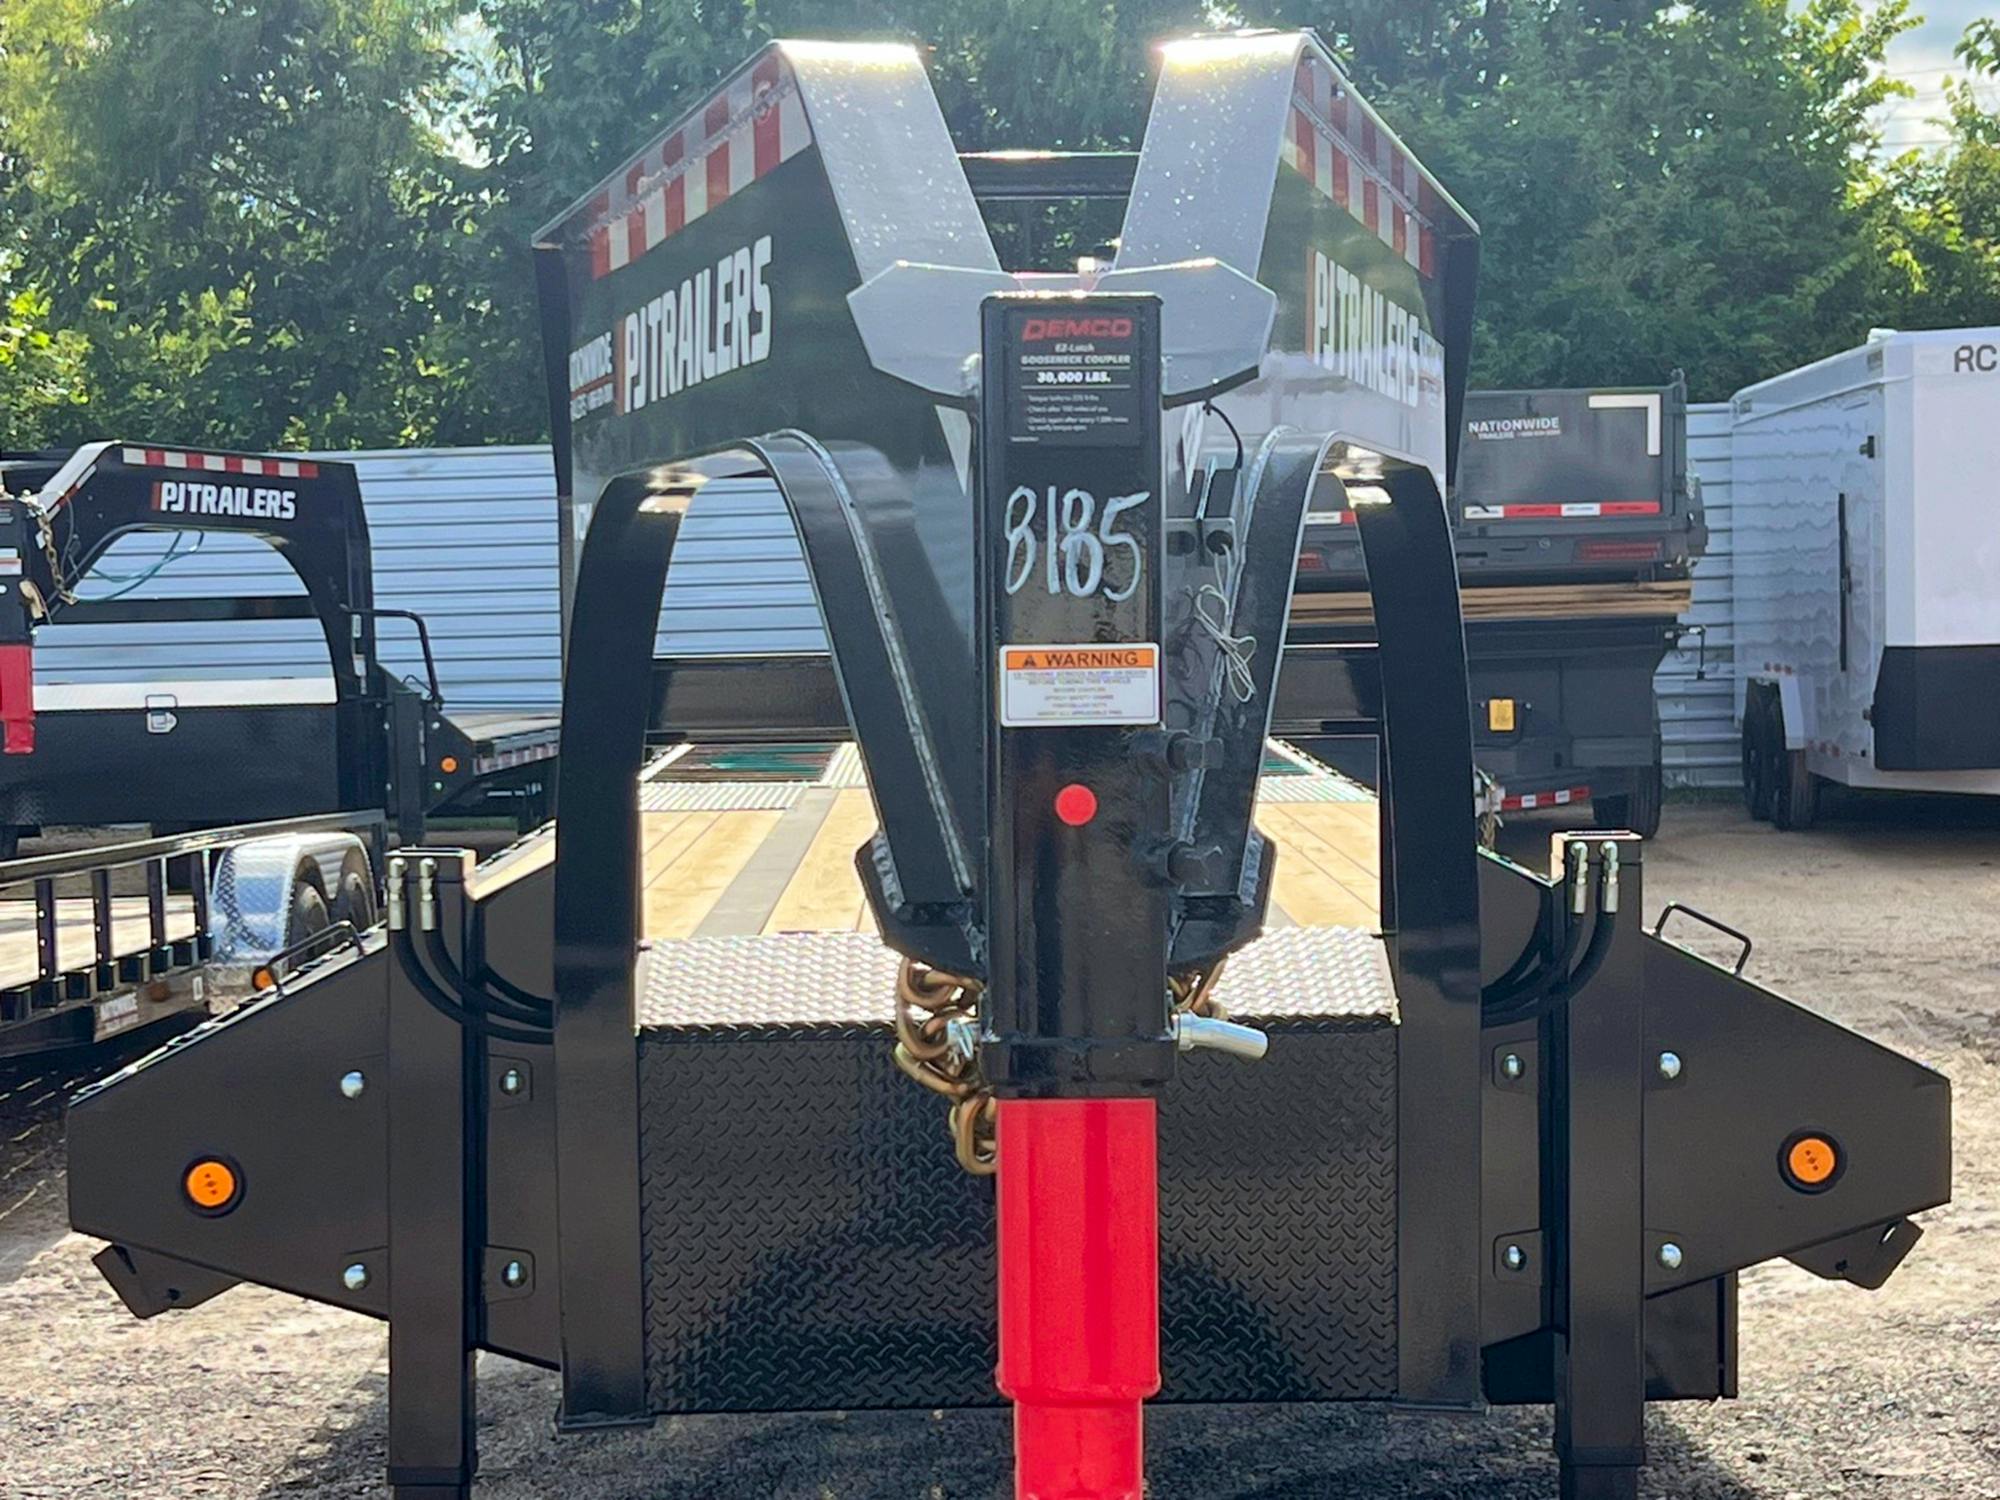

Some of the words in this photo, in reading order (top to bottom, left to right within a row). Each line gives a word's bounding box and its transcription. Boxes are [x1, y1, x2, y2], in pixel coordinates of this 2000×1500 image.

[1023, 318, 1133, 341] DEMCO
[1021, 354, 1083, 365] GOOSENECK
[1084, 353, 1131, 364] COUPLER
[1954, 344, 1997, 372] RC
[1037, 371, 1083, 384] 30,000
[1085, 371, 1111, 383] LBS.
[1468, 417, 1559, 432] NATIONWIDE
[1004, 485, 1150, 602] 8185
[1046, 651, 1138, 666] WARNING
